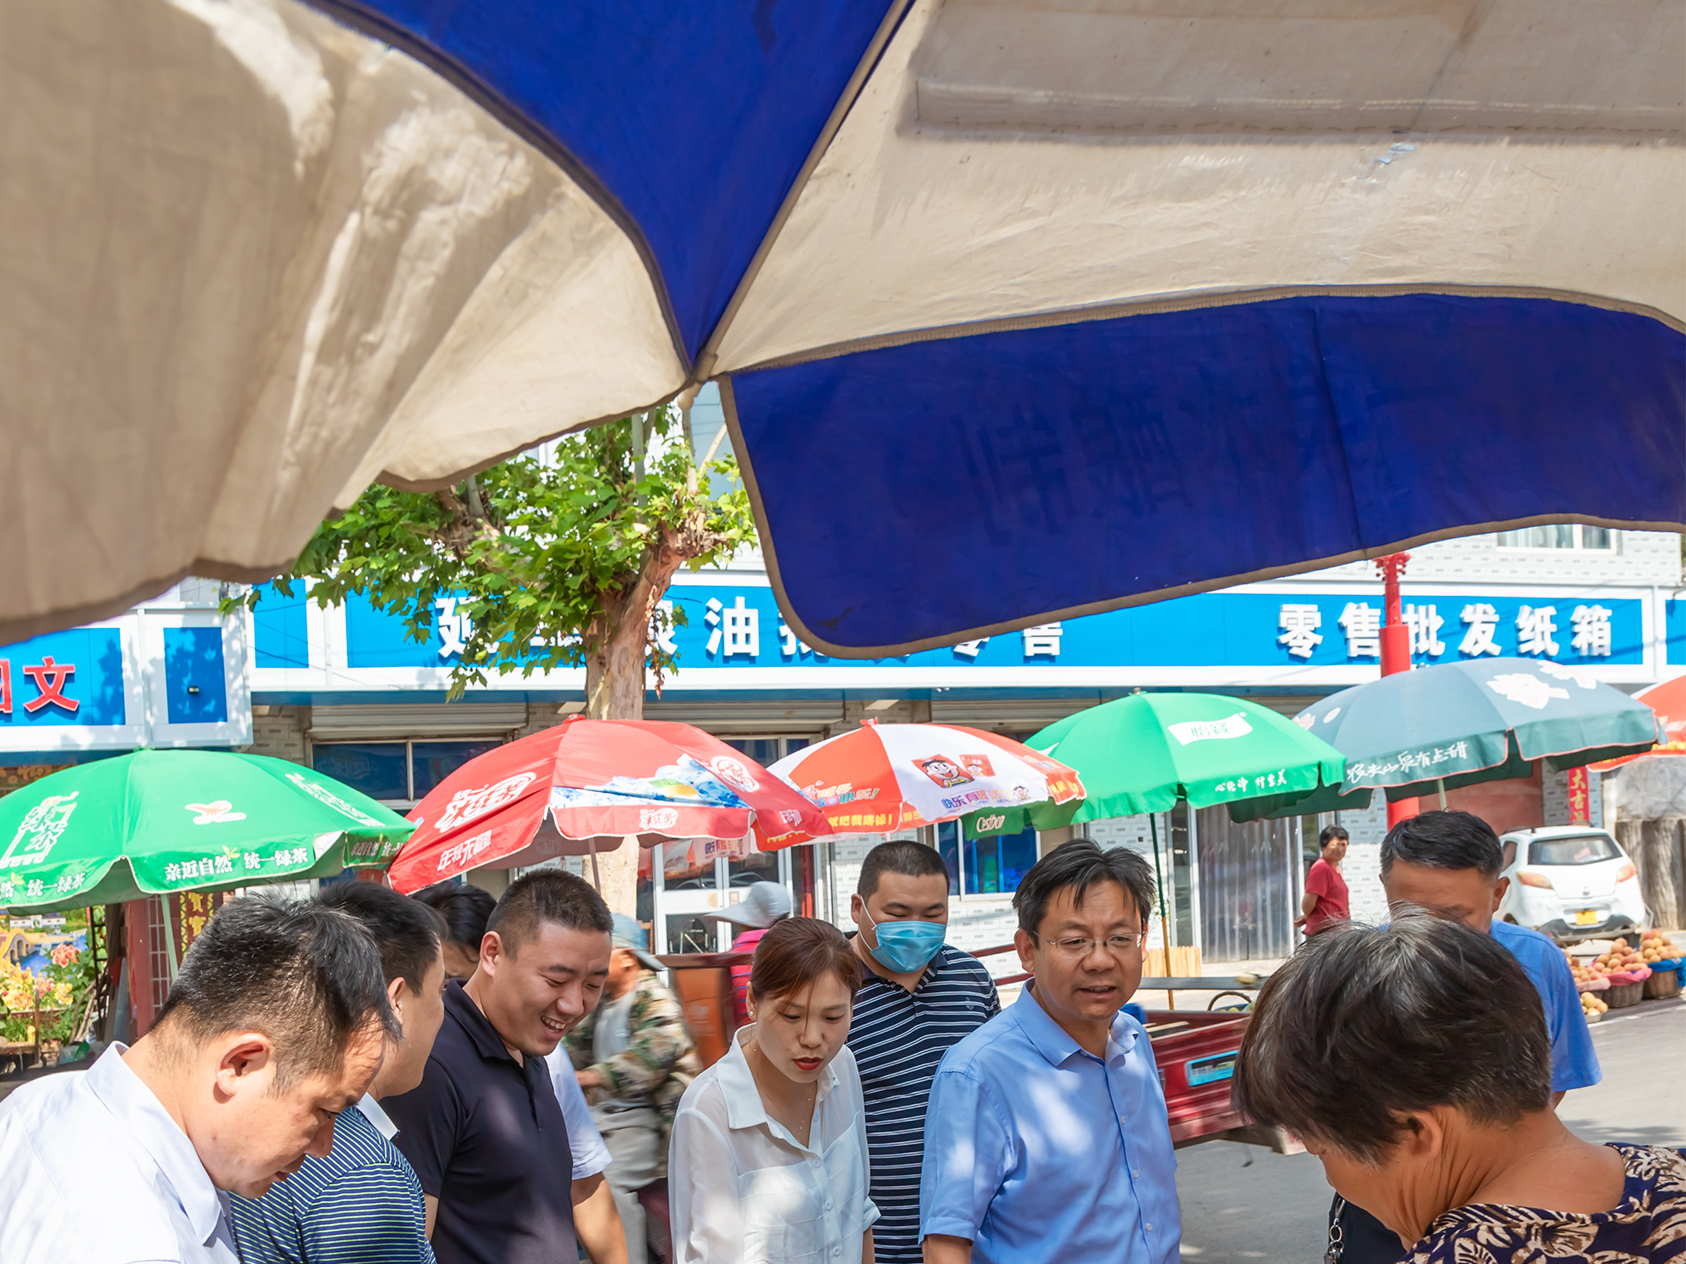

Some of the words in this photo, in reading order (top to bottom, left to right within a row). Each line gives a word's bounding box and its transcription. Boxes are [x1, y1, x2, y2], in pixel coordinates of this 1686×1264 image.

[1278, 601, 1612, 659] 零售批发纸箱
[1347, 741, 1467, 784] 农夫山泉有点甜
[164, 855, 233, 881] 亲近自然
[243, 847, 309, 869] 统一绿茶
[26, 872, 86, 897] 统一绿茶
